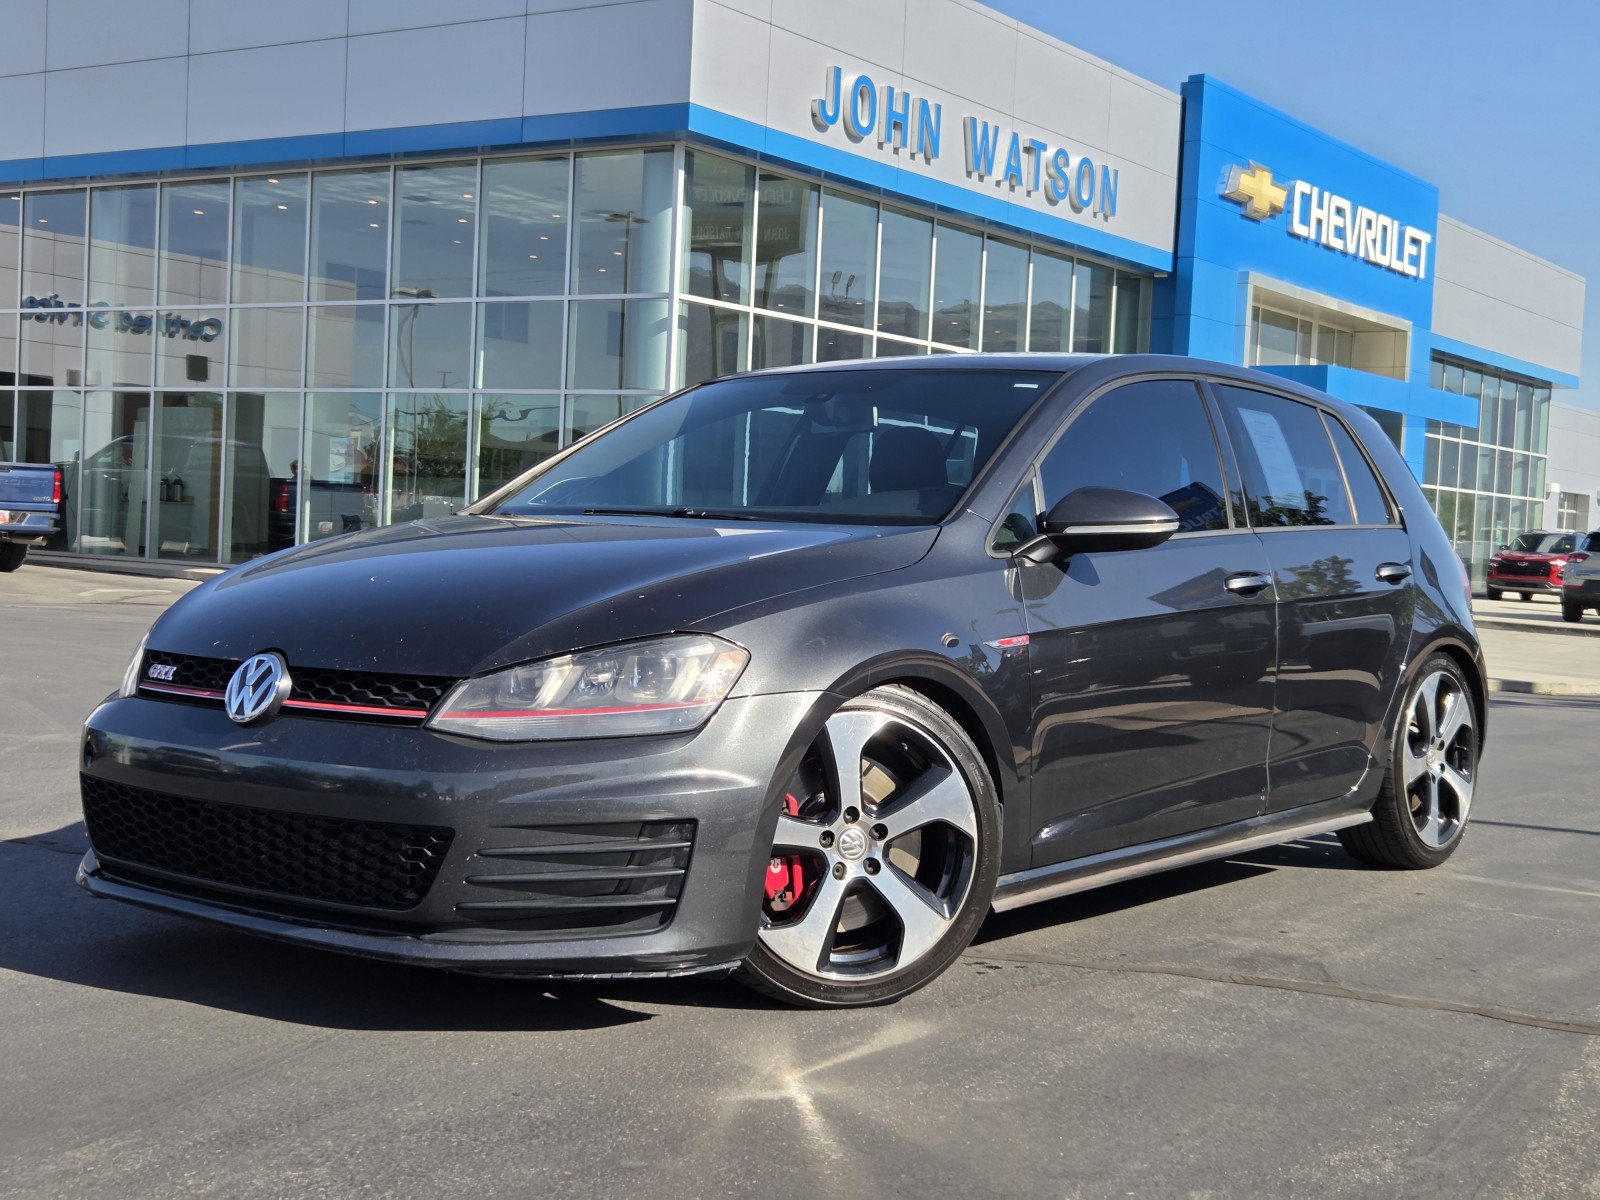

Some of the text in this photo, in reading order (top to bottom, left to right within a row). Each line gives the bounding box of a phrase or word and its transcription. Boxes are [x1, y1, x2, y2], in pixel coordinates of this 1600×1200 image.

[811, 66, 1119, 218] JOHN WATSON
[1291, 179, 1432, 279] CHEVROLET
[148, 663, 178, 681] GTI
